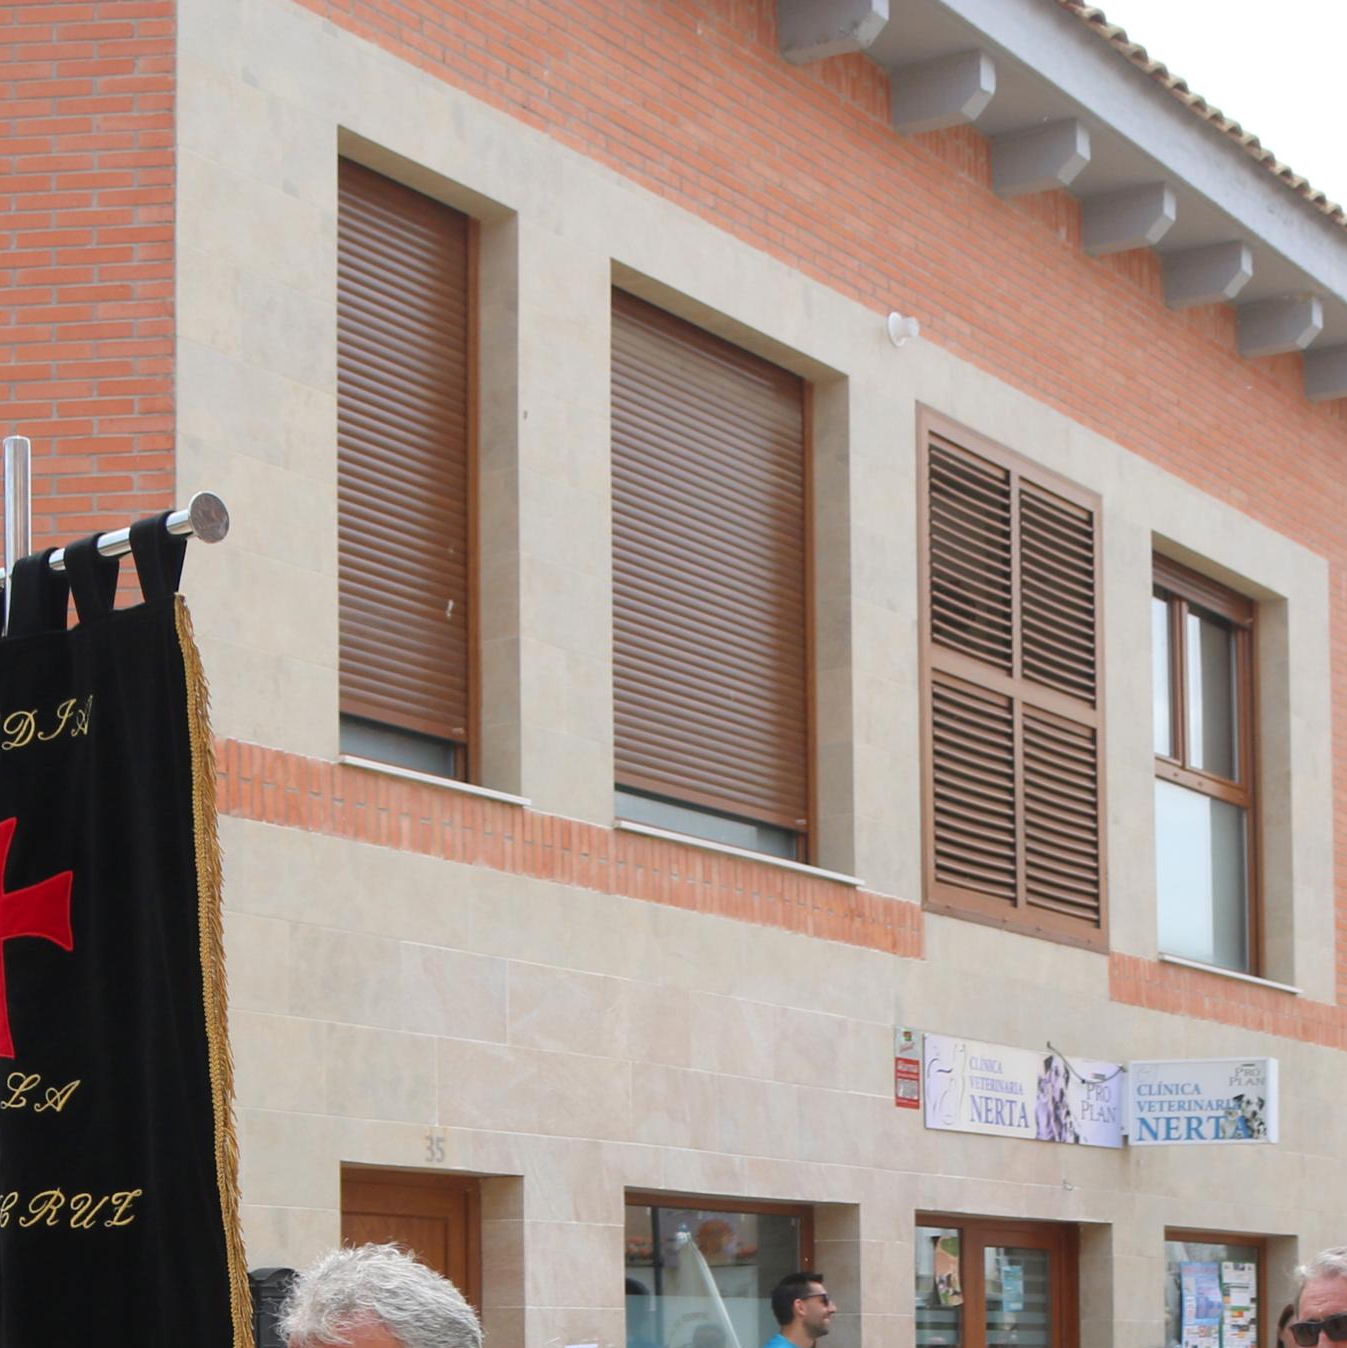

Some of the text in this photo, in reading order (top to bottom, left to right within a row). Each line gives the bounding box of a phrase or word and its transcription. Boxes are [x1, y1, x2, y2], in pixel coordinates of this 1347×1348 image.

[1228, 1077, 1265, 1087] PLAN
[1235, 1067, 1261, 1077] PRO
[0, 1072, 81, 1112] LA
[968, 1075, 1024, 1096] VETERINARIA
[1086, 1083, 1112, 1103] PRO
[1136, 1081, 1202, 1096] CLÍNICA
[969, 1094, 1030, 1129] NERTA
[1081, 1101, 1117, 1124] PLAN
[1136, 1099, 1242, 1113] VETERINARIA
[1136, 1115, 1254, 1142] NERTA
[425, 1135, 445, 1163] 35
